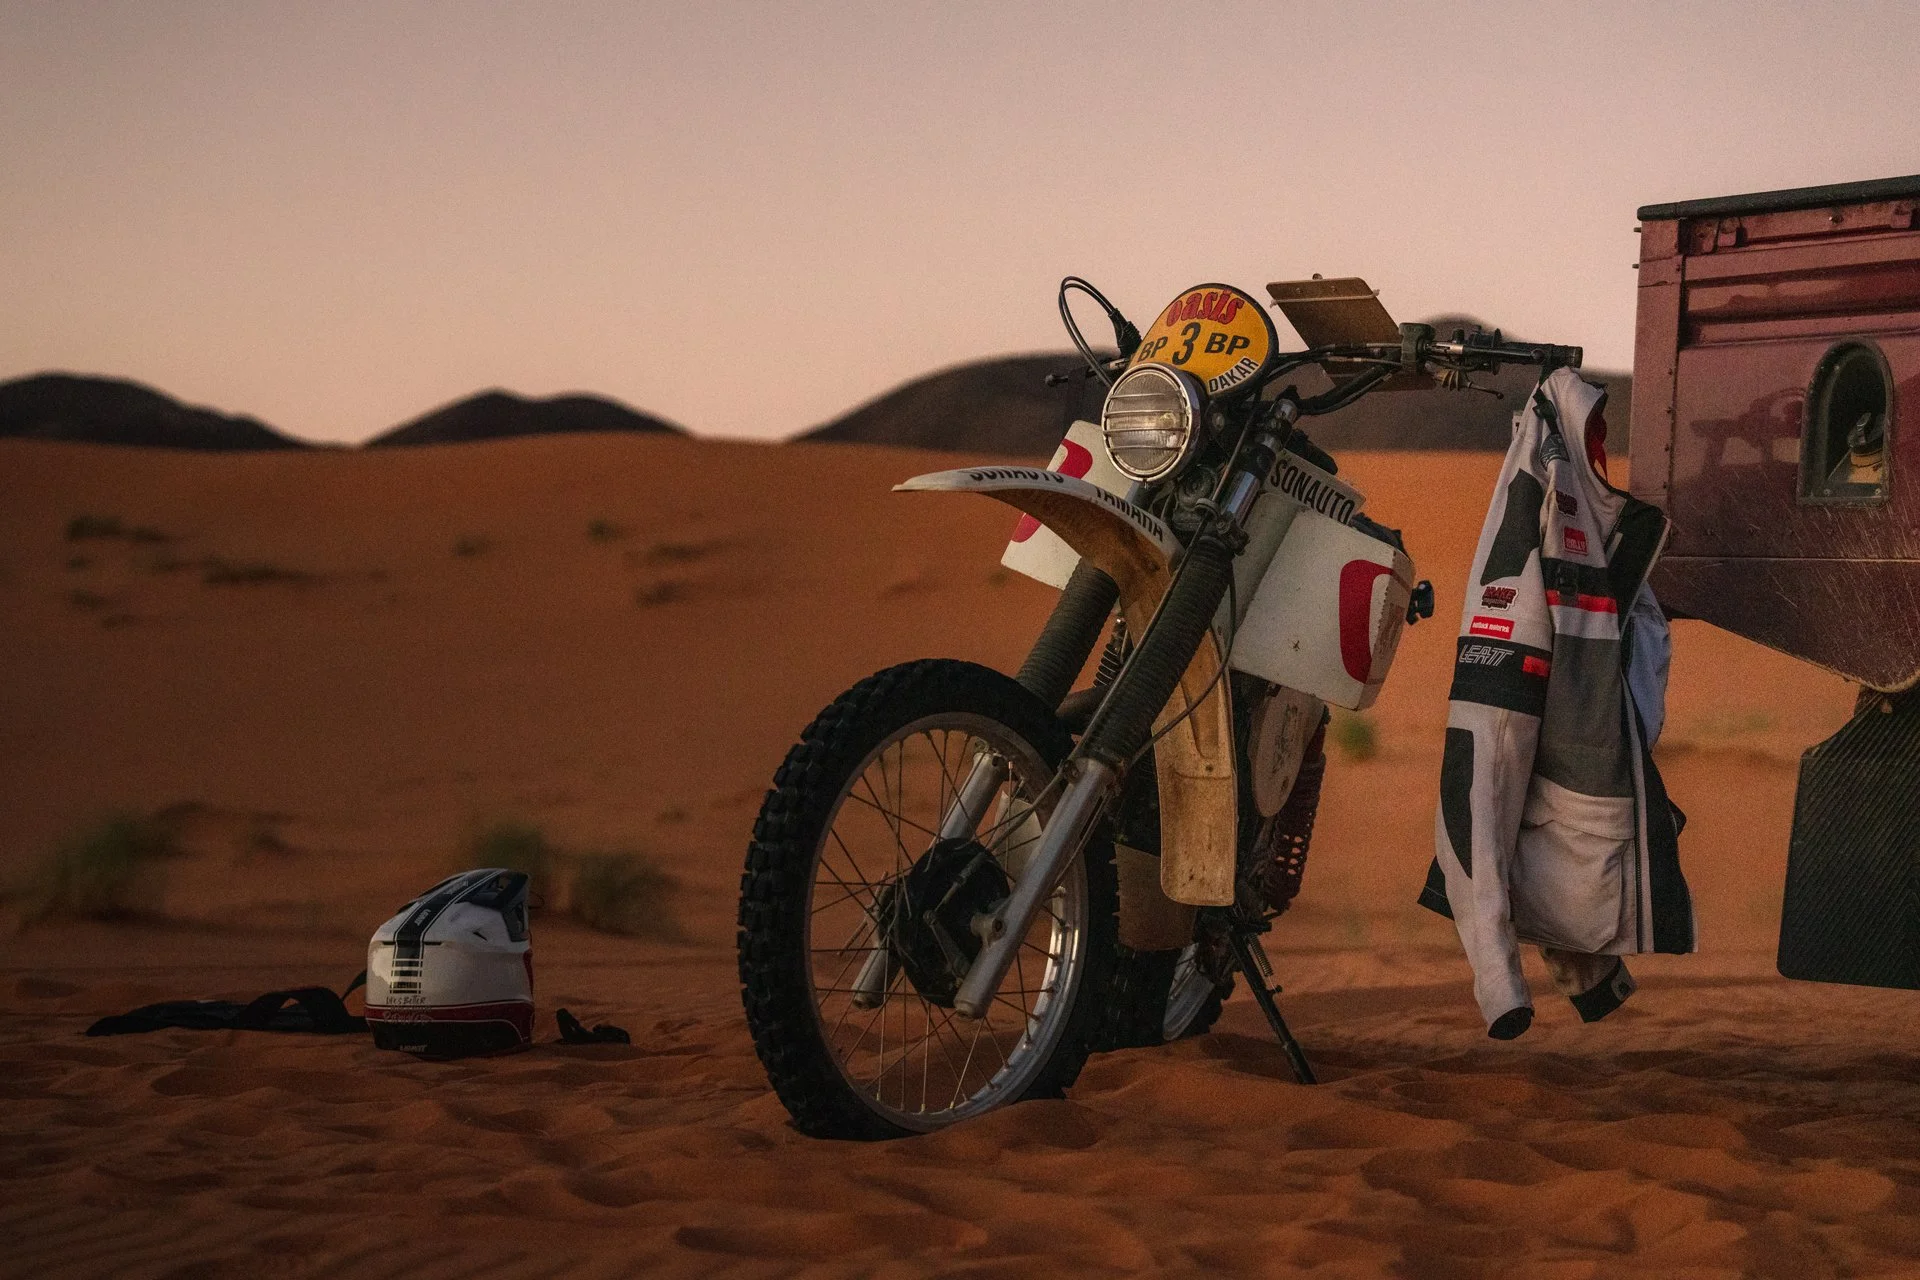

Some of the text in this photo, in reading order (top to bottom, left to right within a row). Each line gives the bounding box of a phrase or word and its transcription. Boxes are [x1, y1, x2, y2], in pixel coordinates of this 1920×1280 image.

[1137, 321, 1250, 366] BP 3 BP
[1209, 356, 1260, 394] DAKAR
[1270, 458, 1356, 525] SONAUTO
[1459, 643, 1515, 667] LEATT
